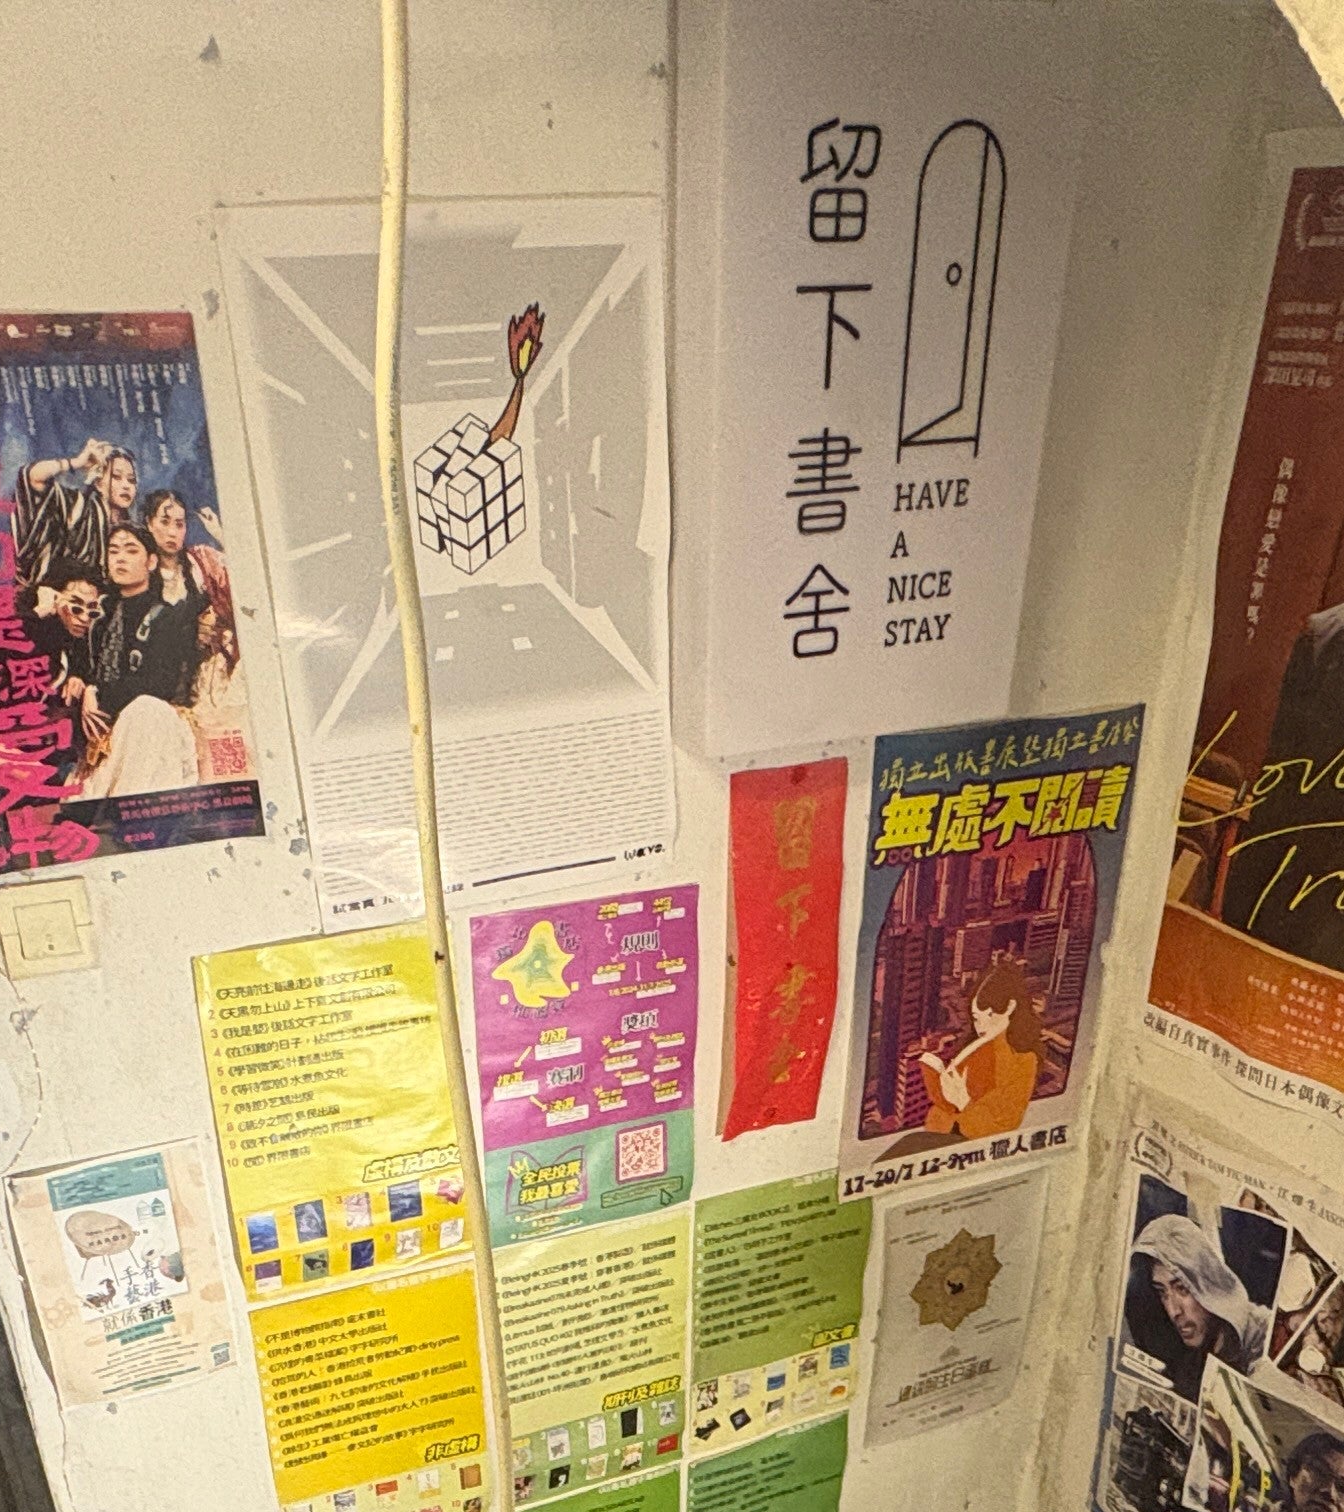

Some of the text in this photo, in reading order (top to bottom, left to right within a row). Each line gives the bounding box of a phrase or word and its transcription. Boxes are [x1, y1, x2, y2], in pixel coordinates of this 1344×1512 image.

[783, 118, 882, 659] 留下書舍
[893, 478, 970, 512] HAVE
[890, 530, 910, 559] A
[887, 570, 953, 604] NICE
[883, 613, 953, 648] STAY
[874, 764, 1134, 867] 無處不閱讀
